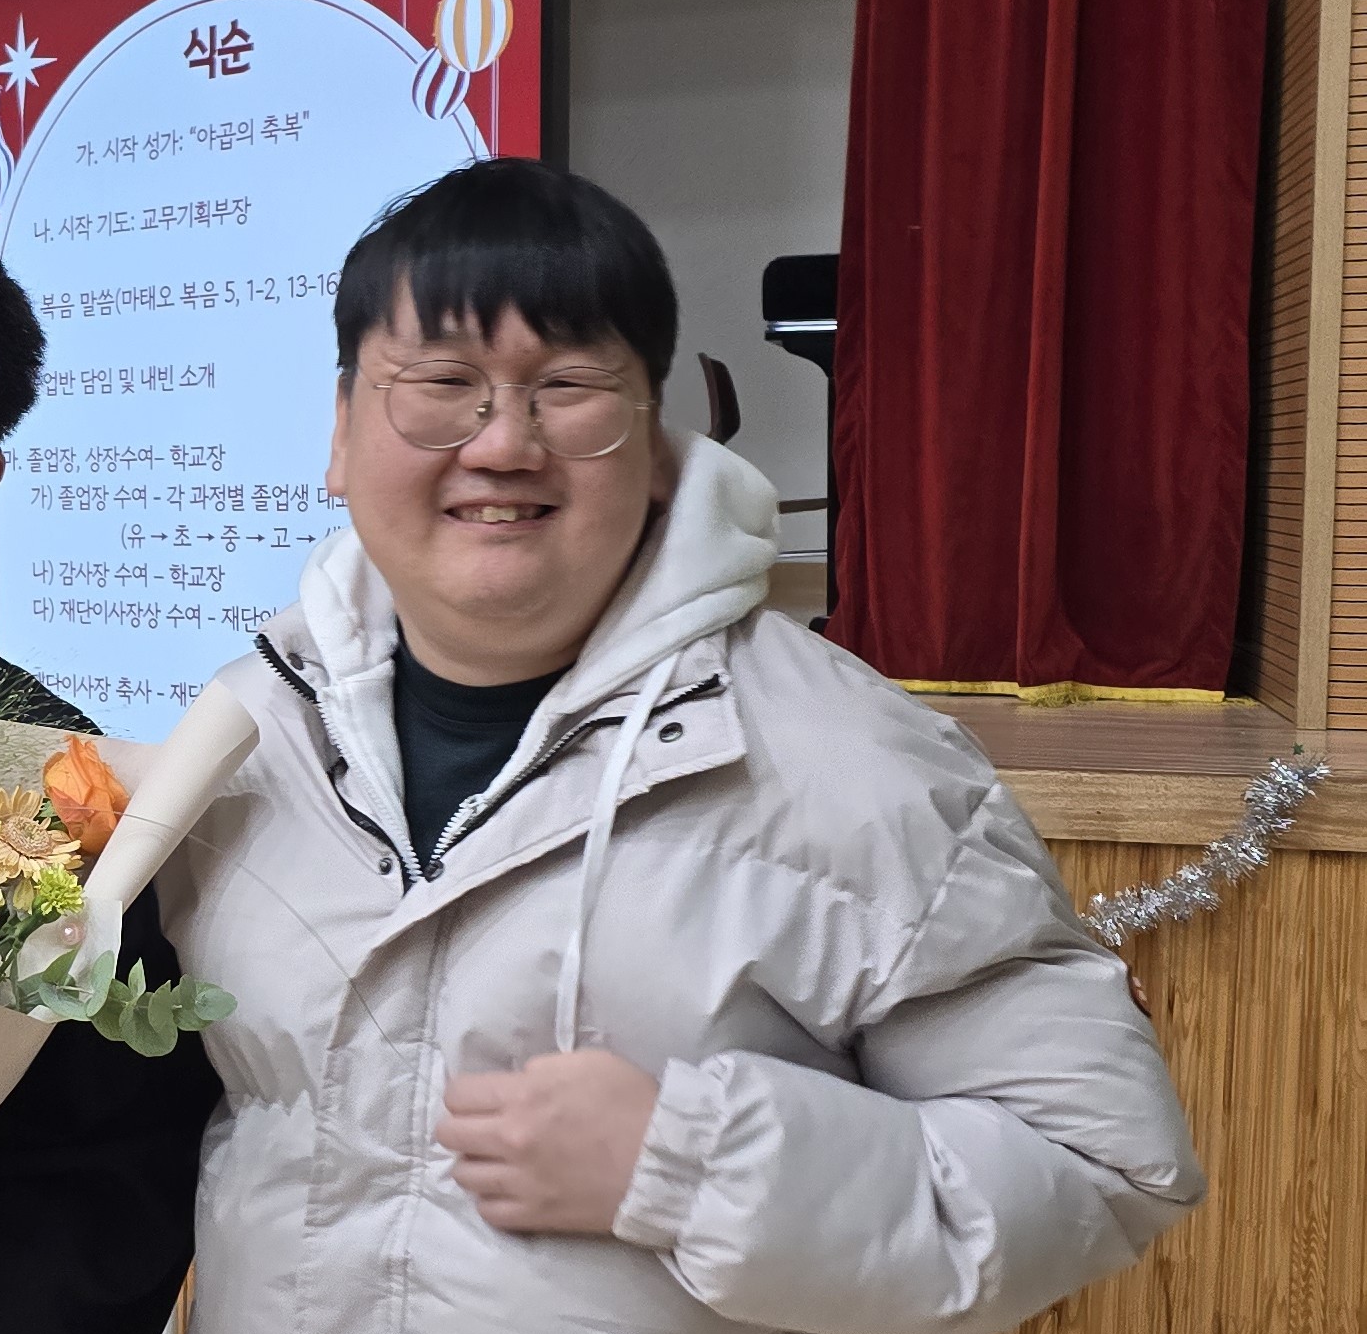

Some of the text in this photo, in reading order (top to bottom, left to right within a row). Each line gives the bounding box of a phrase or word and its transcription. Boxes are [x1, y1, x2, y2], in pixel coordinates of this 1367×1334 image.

[183, 17, 255, 80] 식순
[75, 140, 99, 167] 가.
[102, 134, 139, 164] 시작
[142, 128, 184, 161] 성가:
[33, 195, 252, 244] 나. 시작 기도: 교무기획부장
[39, 292, 75, 320] 복음
[79, 285, 175, 318] 말씀(마태오
[179, 280, 220, 310] 복음
[224, 280, 240, 307] 5,
[246, 277, 281, 305] 1-2,
[80, 367, 113, 395] 담임
[118, 366, 135, 395] 및
[140, 364, 174, 392] 내빈
[179, 362, 216, 389] 소개
[26, 446, 81, 473] 졸업장,
[169, 443, 227, 472] 학교장
[30, 484, 53, 511] 가)
[58, 484, 110, 512] 졸업장
[113, 484, 147, 510] 수여
[166, 483, 186, 512] 각
[189, 483, 245, 513] 과정별
[250, 483, 310, 513] 졸업생
[120, 522, 291, 553] (유 초 중 고
[32, 559, 54, 586] 나)
[59, 560, 110, 588] 감사장
[114, 562, 148, 588] 수여
[169, 563, 226, 593] 학교장
[33, 597, 55, 623] 다)
[59, 598, 161, 630] 재단이사장상
[166, 603, 201, 630] 수여
[115, 676, 153, 705] 축사
